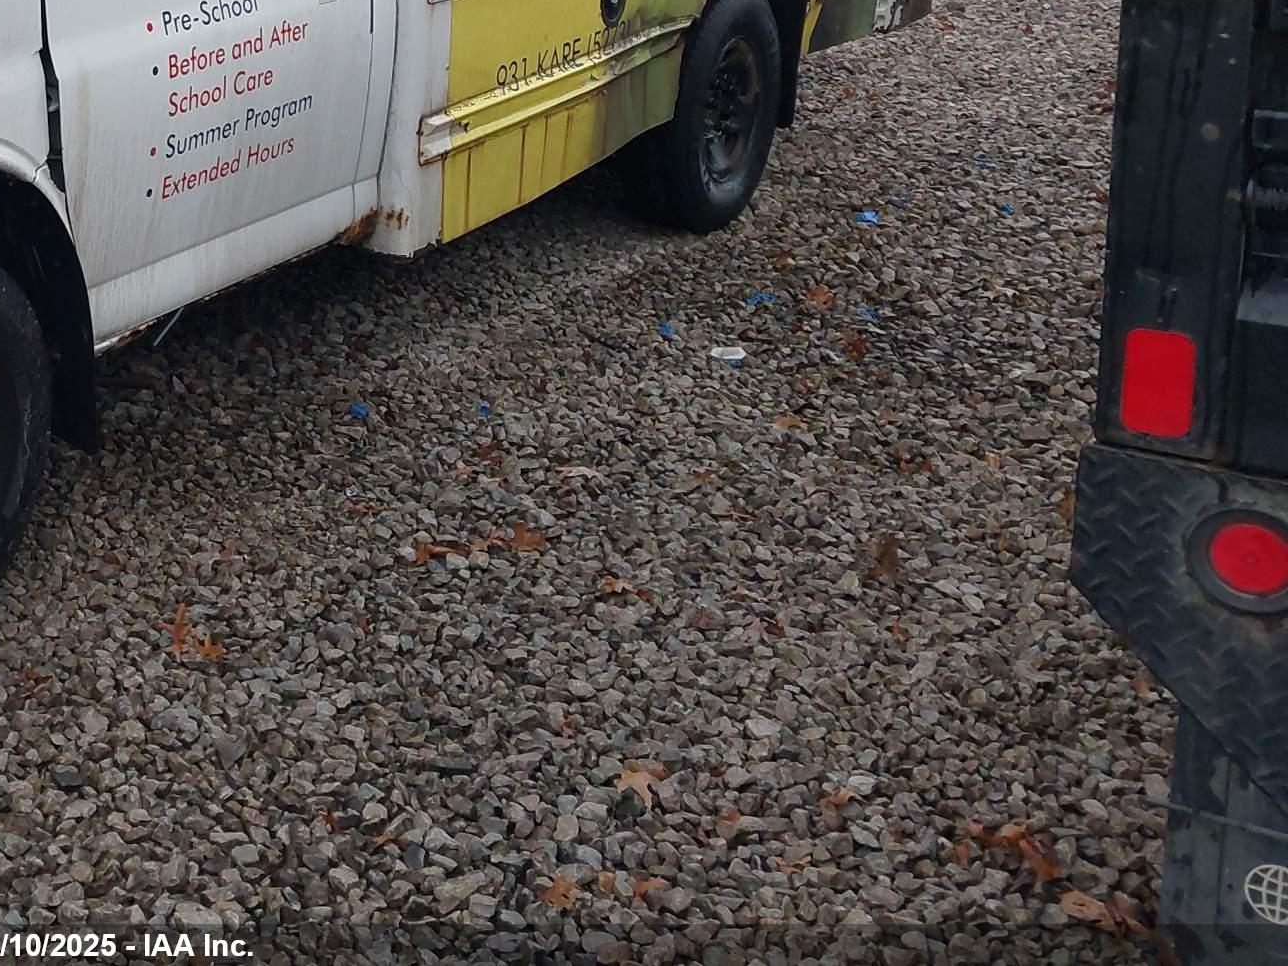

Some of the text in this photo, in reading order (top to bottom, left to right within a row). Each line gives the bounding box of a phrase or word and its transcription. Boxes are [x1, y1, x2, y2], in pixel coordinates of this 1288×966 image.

[168, 20, 309, 80] Before and After
[168, 70, 274, 117] School Care
[165, 95, 313, 158] Summer Program
[161, 138, 295, 199] Extended Hours
